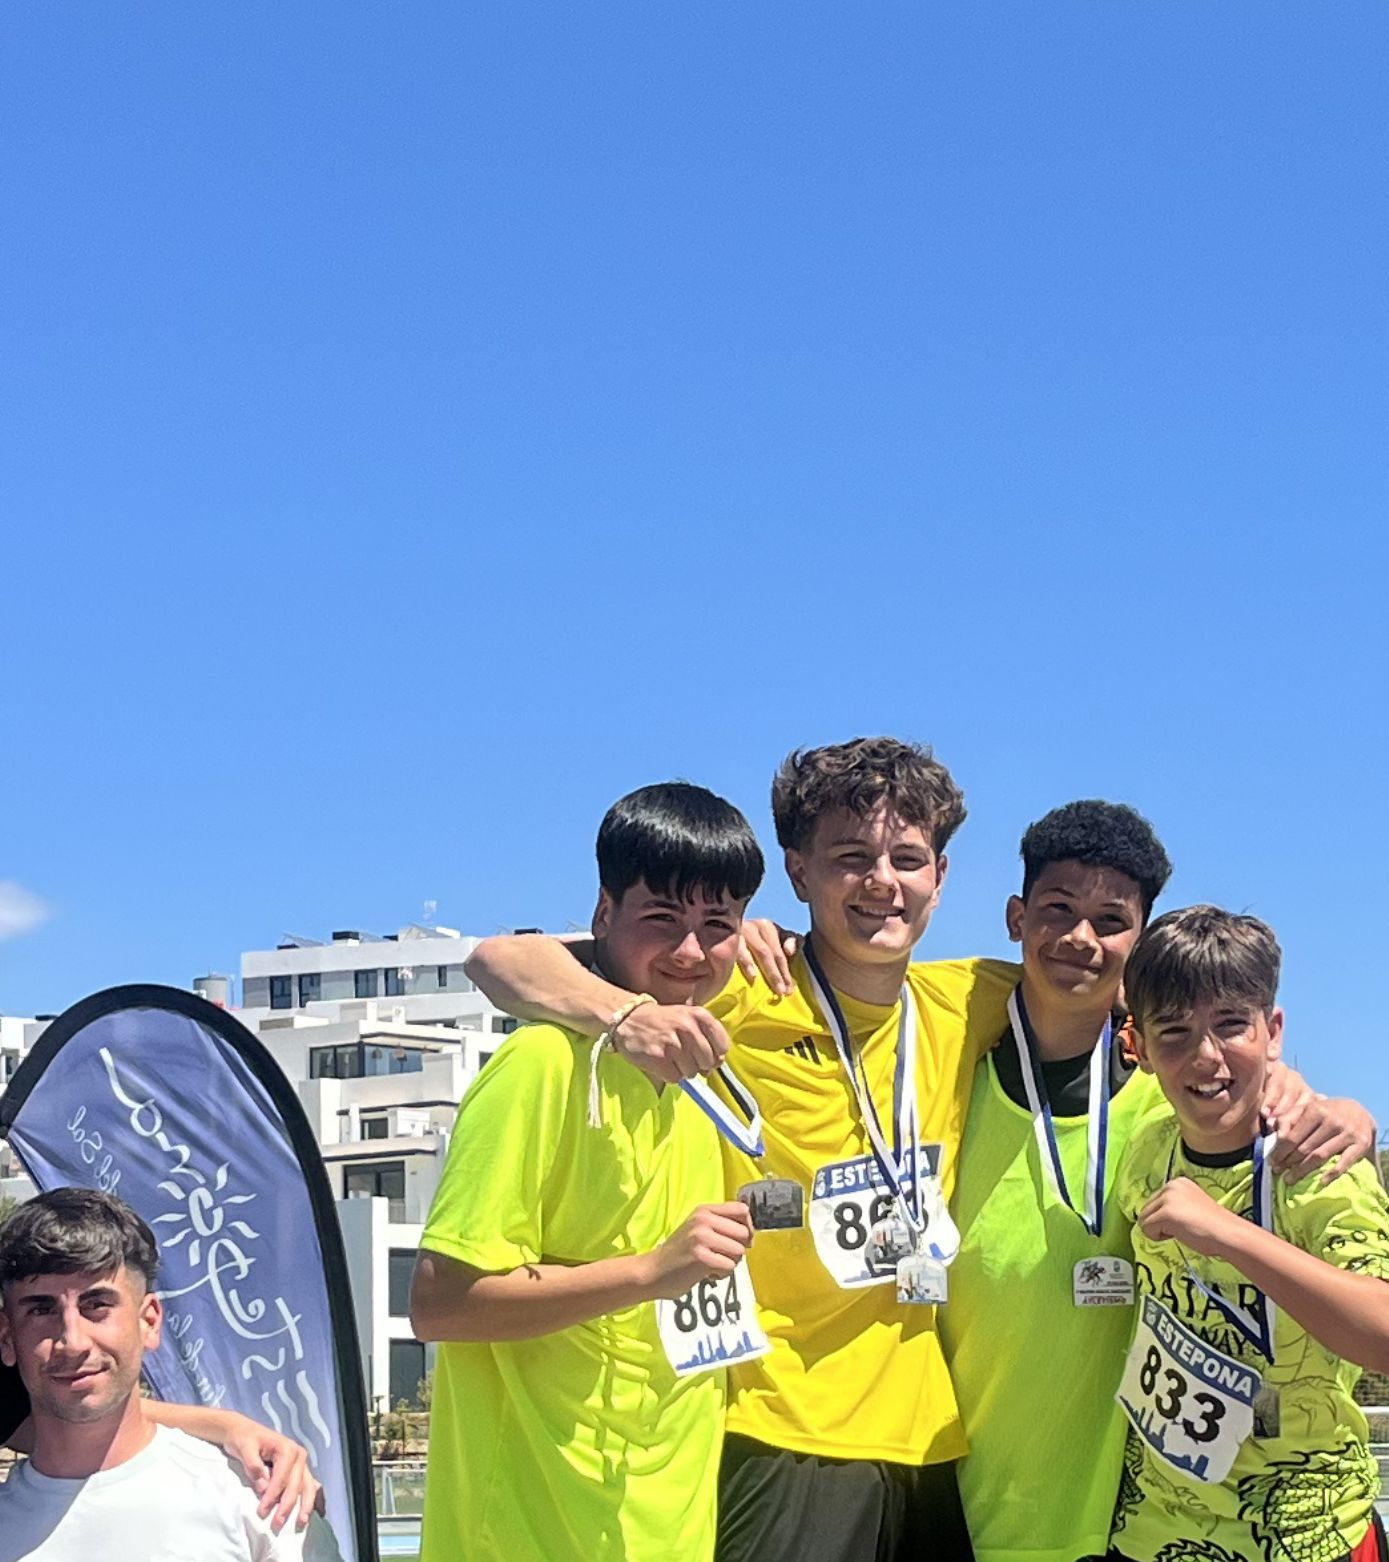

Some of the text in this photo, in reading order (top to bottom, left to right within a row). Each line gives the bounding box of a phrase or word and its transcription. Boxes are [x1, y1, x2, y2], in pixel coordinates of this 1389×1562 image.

[673, 1271, 743, 1333] 864
[1139, 1344, 1227, 1444] 833
[1156, 1316, 1252, 1398] ESTEPONA
